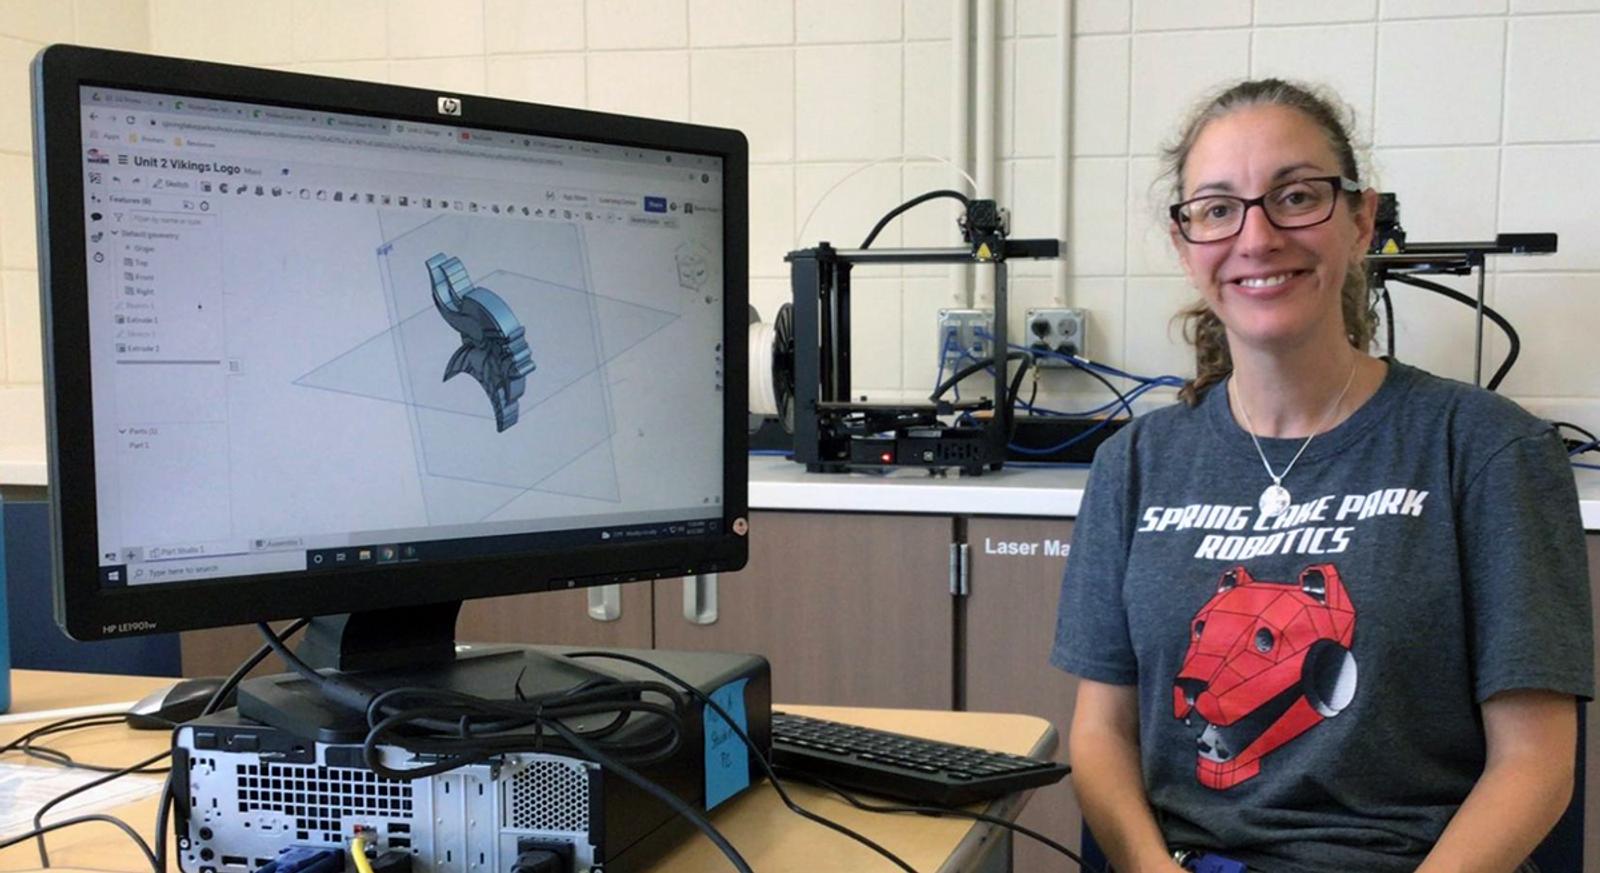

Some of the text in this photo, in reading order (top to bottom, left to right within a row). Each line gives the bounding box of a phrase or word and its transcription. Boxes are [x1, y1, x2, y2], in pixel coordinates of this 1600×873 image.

[134, 156, 158, 168] Unit
[160, 158, 168, 169] 2
[170, 159, 211, 174] Vikings
[213, 162, 241, 176] Logo
[165, 179, 190, 189] Sketch
[109, 194, 140, 205] Features
[121, 230, 180, 241] Default geometry
[134, 244, 155, 254] Origin
[135, 259, 149, 268] Top
[135, 273, 154, 281] Front
[136, 287, 155, 297] Right
[126, 316, 153, 325] Extrude
[127, 344, 154, 353] Extrude
[1138, 488, 1430, 532] SPRING LAKE PARK
[985, 537, 1039, 556] Laser
[1193, 527, 1355, 561] ROBOTICS
[150, 568, 166, 578] Type
[167, 566, 184, 575] here
[195, 564, 219, 574] search
[102, 621, 158, 635] HP LE1901w
